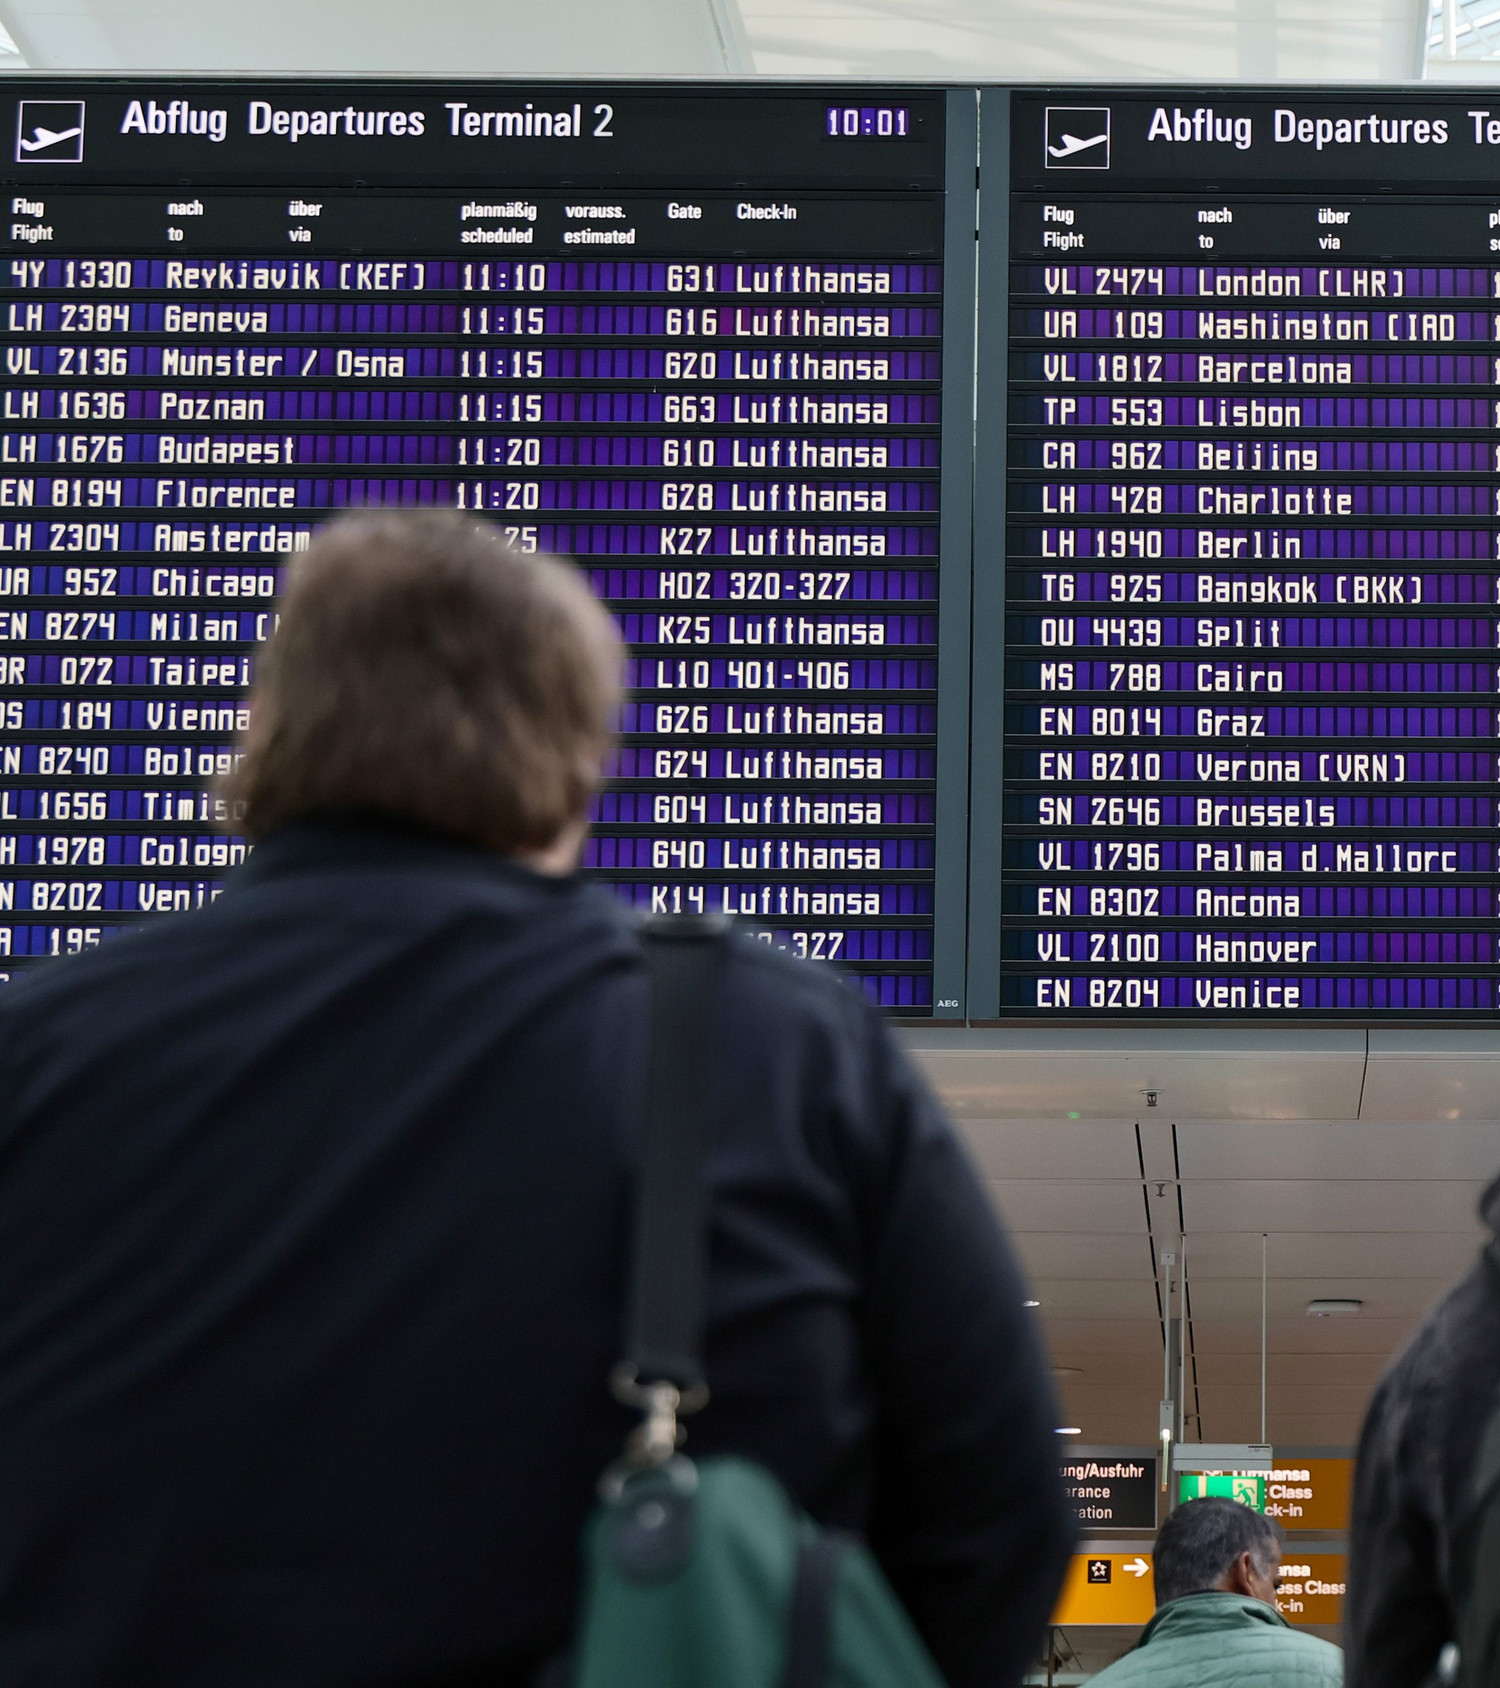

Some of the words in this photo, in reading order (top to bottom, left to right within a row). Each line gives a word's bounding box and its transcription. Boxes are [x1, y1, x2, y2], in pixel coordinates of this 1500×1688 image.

[121, 101, 227, 141] Abflug
[250, 102, 424, 142] Departures
[445, 103, 580, 136] Terminal
[594, 104, 613, 136] 2
[830, 110, 905, 135] 10:01
[1148, 108, 1251, 149] Abflug
[1275, 110, 1448, 150] Departures
[13, 198, 44, 217] Flug
[168, 200, 203, 215] nach
[289, 200, 322, 216] über
[461, 202, 537, 221] planmäßig
[565, 206, 626, 218] vorauss.
[668, 203, 701, 219] Gate
[737, 203, 796, 219] Check-In
[1044, 206, 1074, 225] Flug
[1198, 207, 1232, 223] nach
[1318, 208, 1350, 224] über
[12, 224, 53, 243] Flight
[168, 227, 183, 241] to
[289, 226, 311, 242] via
[461, 227, 533, 243] scheduled
[564, 228, 635, 244] estimated
[1044, 232, 1084, 250] Flight
[1199, 235, 1213, 248] to
[1319, 234, 1340, 249] via
[10, 305, 42, 331] LH
[61, 305, 129, 331] 2384
[165, 306, 267, 332] Geneva
[463, 308, 543, 334] 11:15
[736, 310, 888, 336] Lufthansa
[1044, 355, 1075, 381] VL
[1099, 355, 1162, 382] 1812
[1199, 356, 1351, 383] Barcelona
[5, 392, 38, 418] LH
[60, 392, 125, 419] 1636
[161, 393, 263, 420] Poznan
[460, 395, 541, 421] 11:15
[734, 397, 887, 423] Lufthansa
[1044, 442, 1075, 469] CA
[1112, 443, 1161, 469] 962
[1199, 443, 1317, 470] Beijing
[1, 479, 34, 506] EN
[53, 480, 121, 507] 8194
[157, 481, 294, 508] Florence
[457, 483, 538, 509] 11:20
[732, 484, 886, 511] Lufthansa
[1043, 530, 1074, 557] LH
[1097, 531, 1161, 558] 1940
[1199, 531, 1300, 558] Berlin
[62, 658, 112, 685] 072
[150, 658, 249, 685] Taipei
[658, 661, 708, 688] L10
[729, 662, 848, 689] 401-406
[1041, 664, 1073, 690] MS
[1111, 664, 1160, 691] 788
[1198, 665, 1282, 692] Cairo
[38, 837, 104, 865] 1978
[141, 838, 253, 866] Cologn
[724, 841, 880, 869] Lufthansa
[1039, 843, 1070, 870] VL
[1095, 843, 1159, 871] 1796
[1197, 844, 1281, 871] Palma
[1302, 845, 1456, 872] d.Mallorc
[1038, 980, 1069, 1007] EN
[1090, 980, 1158, 1007] 8204
[1196, 980, 1299, 1008] Venice
[1061, 1463, 1144, 1480] ung/Ausfuhr
[1269, 1485, 1313, 1499] Class
[1078, 1506, 1112, 1519] ation
[1264, 1503, 1303, 1516] ck-in
[1305, 1580, 1346, 1594] Class
